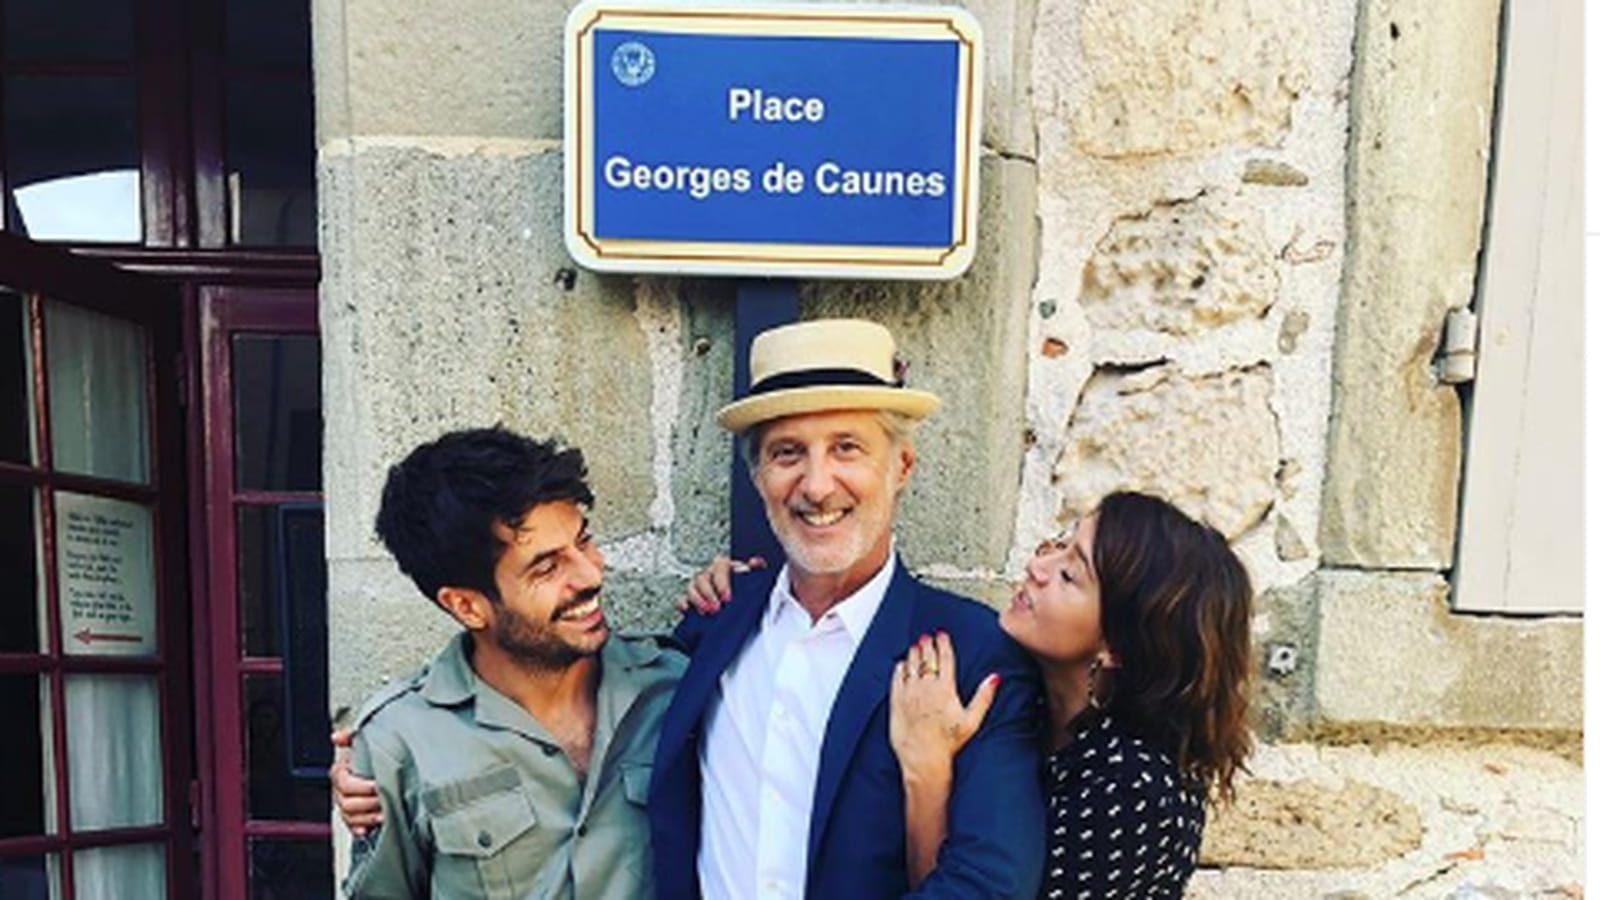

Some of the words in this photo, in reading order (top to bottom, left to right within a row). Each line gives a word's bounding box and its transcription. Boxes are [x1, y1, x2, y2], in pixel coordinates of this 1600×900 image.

[729, 88, 824, 121] Place
[604, 156, 751, 198] Georges
[762, 162, 803, 193] de
[815, 163, 945, 196] Caunes
